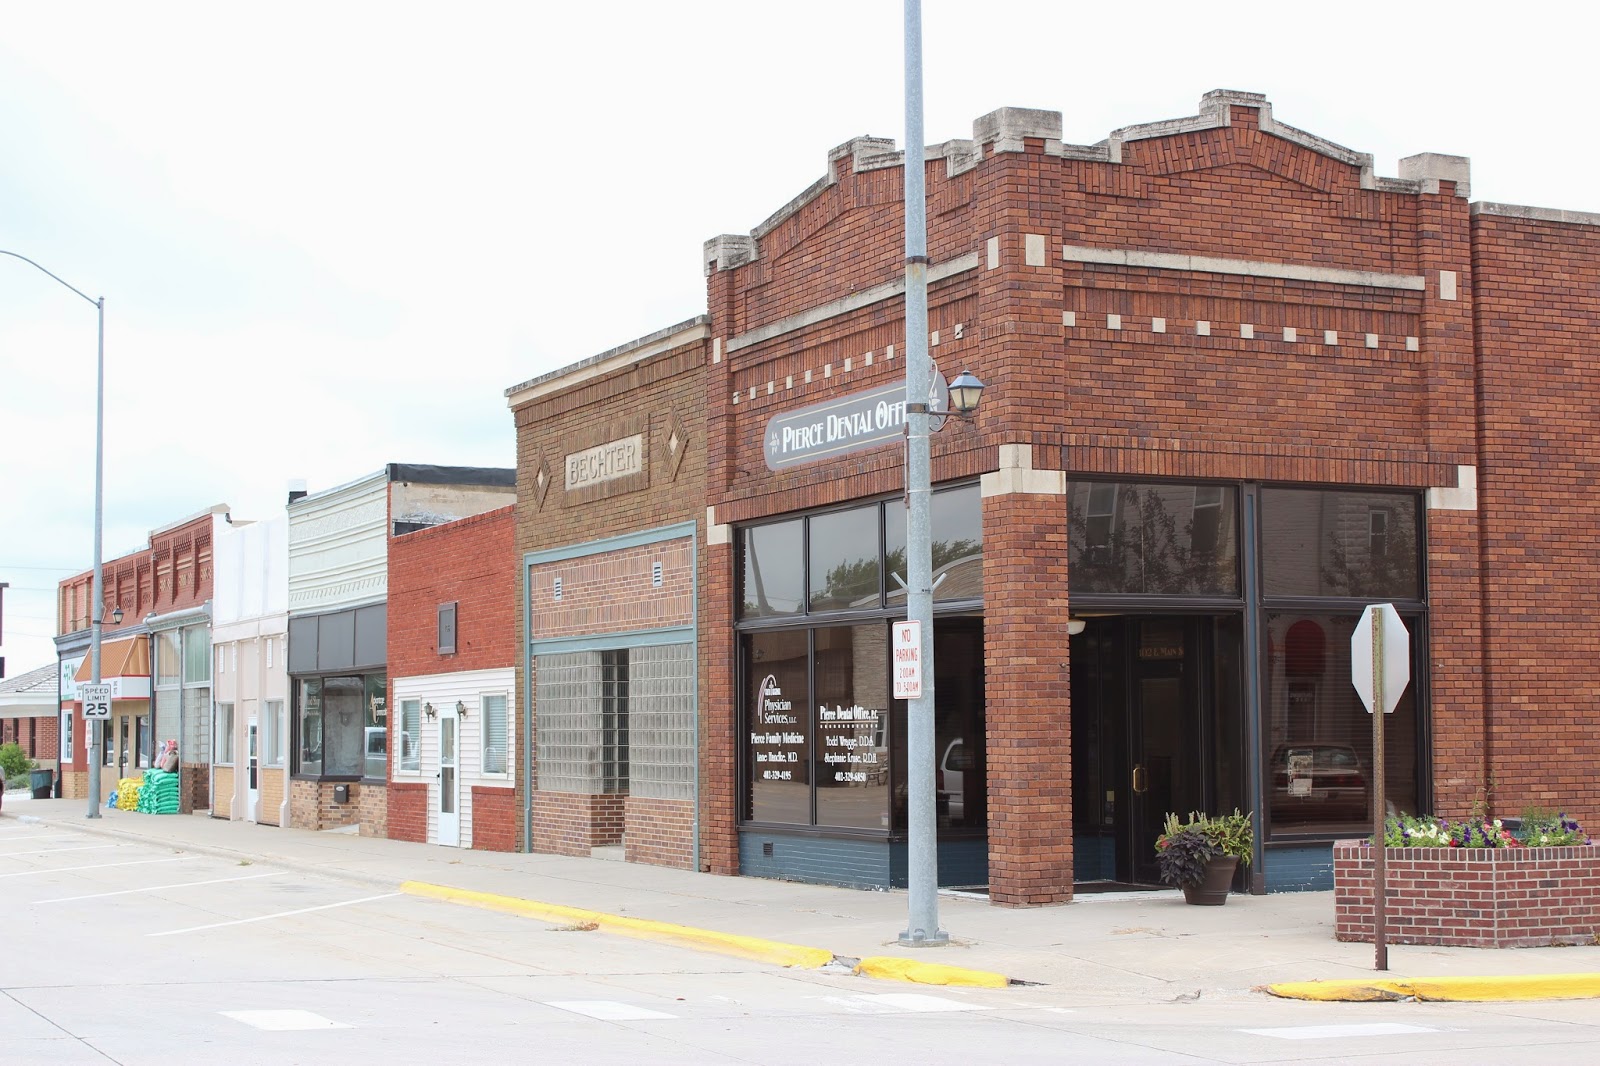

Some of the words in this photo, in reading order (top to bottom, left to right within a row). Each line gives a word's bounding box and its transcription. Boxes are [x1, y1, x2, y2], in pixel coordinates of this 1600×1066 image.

[782, 423, 824, 453] PIERCE
[826, 410, 874, 443] DENTAL
[875, 400, 907, 429] OFFI
[570, 443, 636, 485] BECHTER
[902, 629, 911, 643] NO
[896, 648, 918, 663] PARKING
[896, 682, 902, 693] TO
[86, 703, 108, 716] 25
[764, 699, 792, 713] Physician
[820, 705, 836, 720] Pierce
[836, 705, 853, 720] Dental
[751, 732, 765, 744] Pierce
[765, 732, 781, 747] Family
[782, 732, 804, 744] Medicine
[826, 735, 839, 746] Todd
